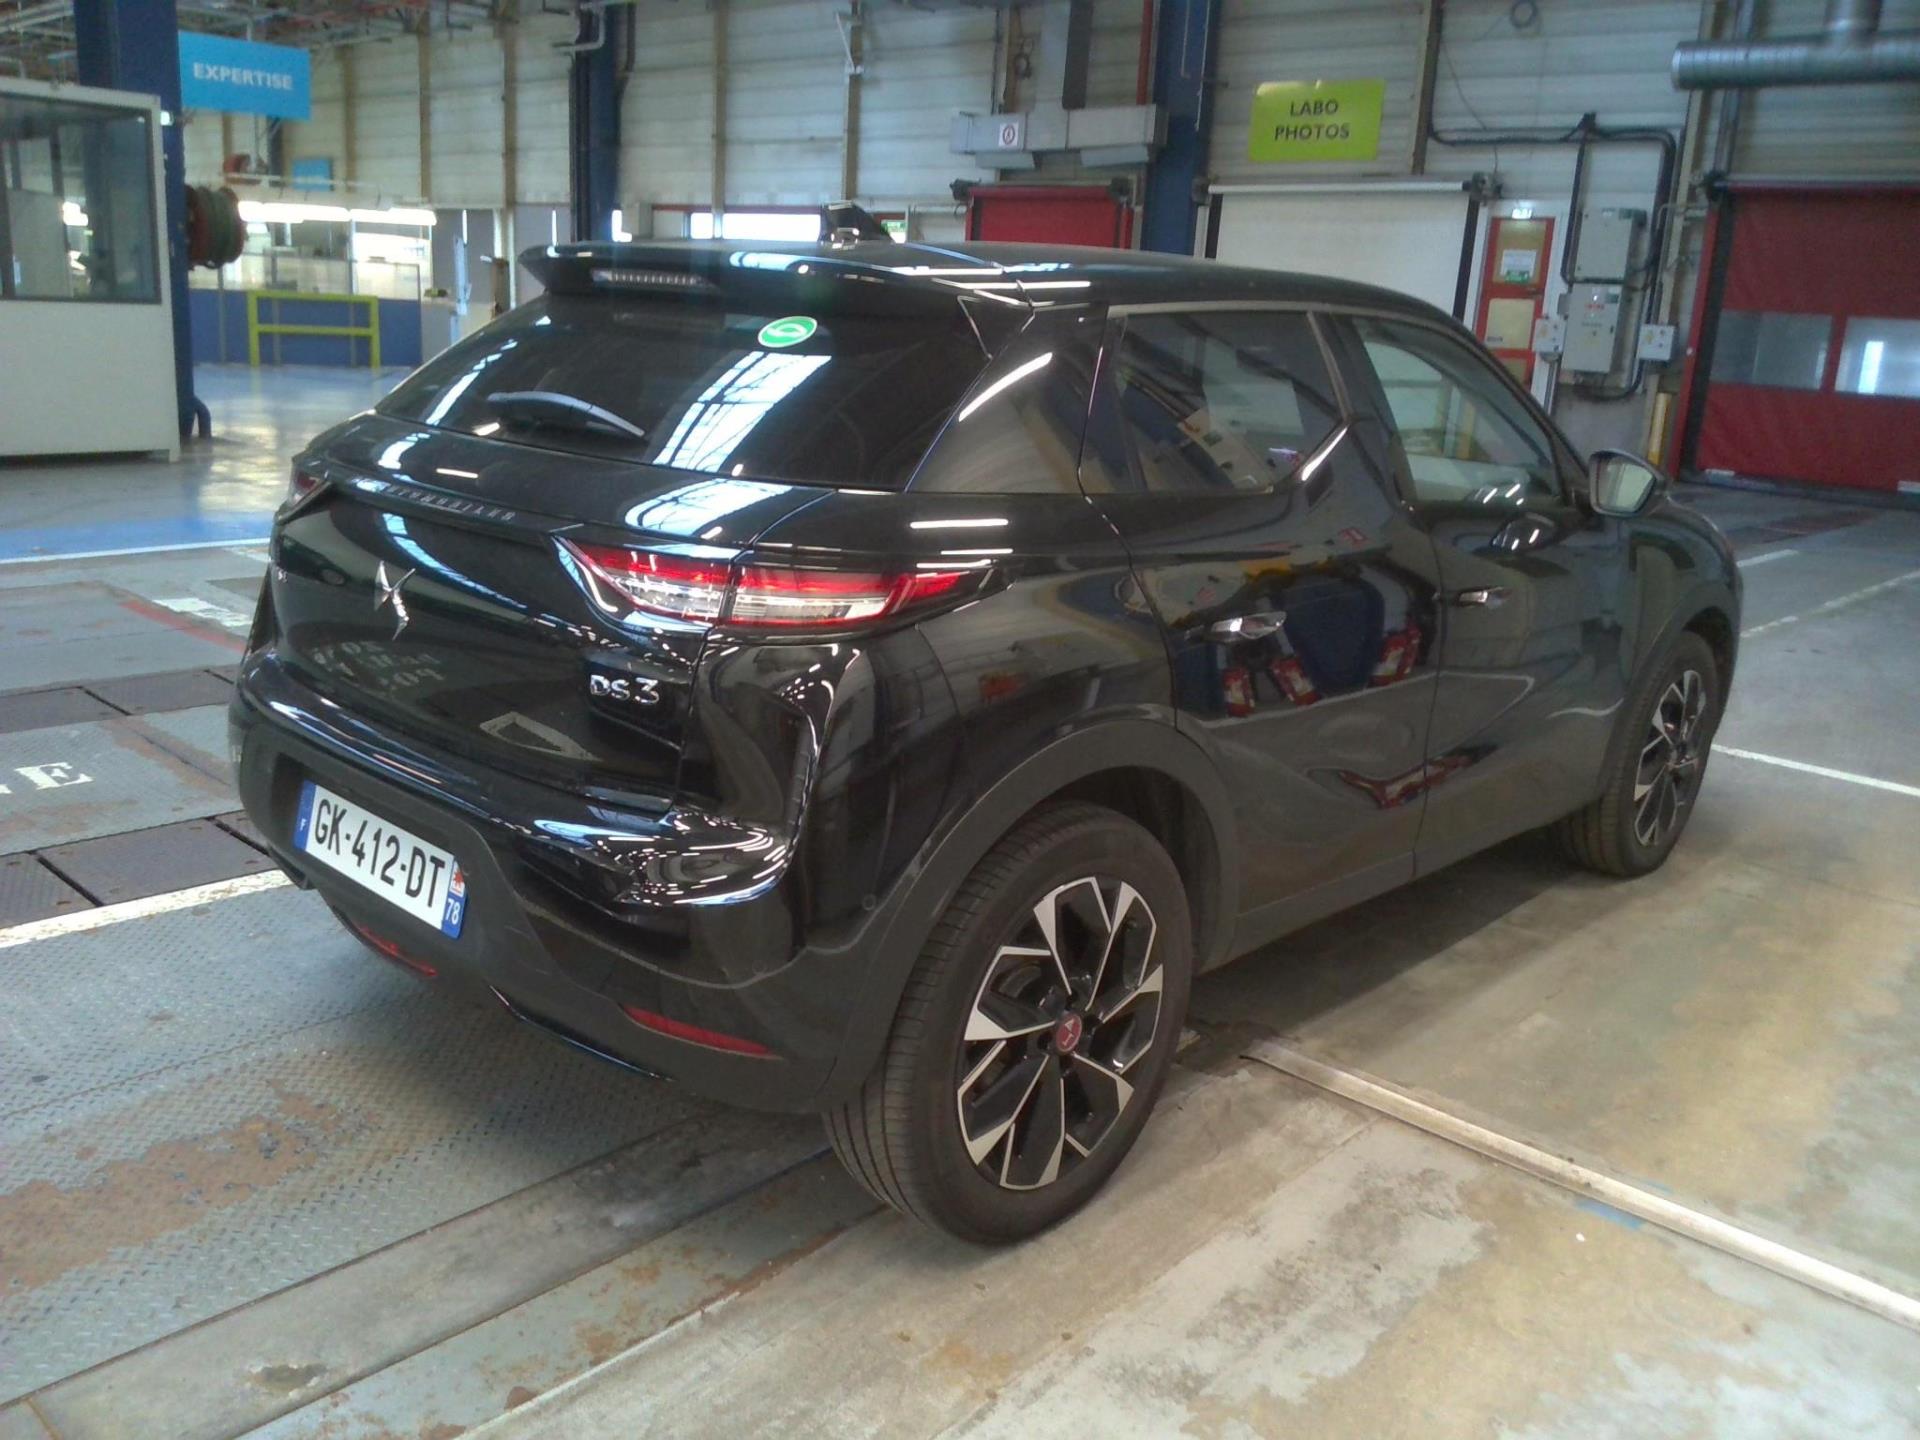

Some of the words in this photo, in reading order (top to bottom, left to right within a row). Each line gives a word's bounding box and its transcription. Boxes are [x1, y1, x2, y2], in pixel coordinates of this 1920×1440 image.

[193, 62, 293, 90] EXPERTISE
[1289, 99, 1339, 118] LABO
[1274, 122, 1350, 141] PHOTOS
[590, 674, 631, 700] DS
[635, 677, 660, 705] 3
[314, 799, 445, 908] GK-412-DT
[447, 898, 461, 925] 78
